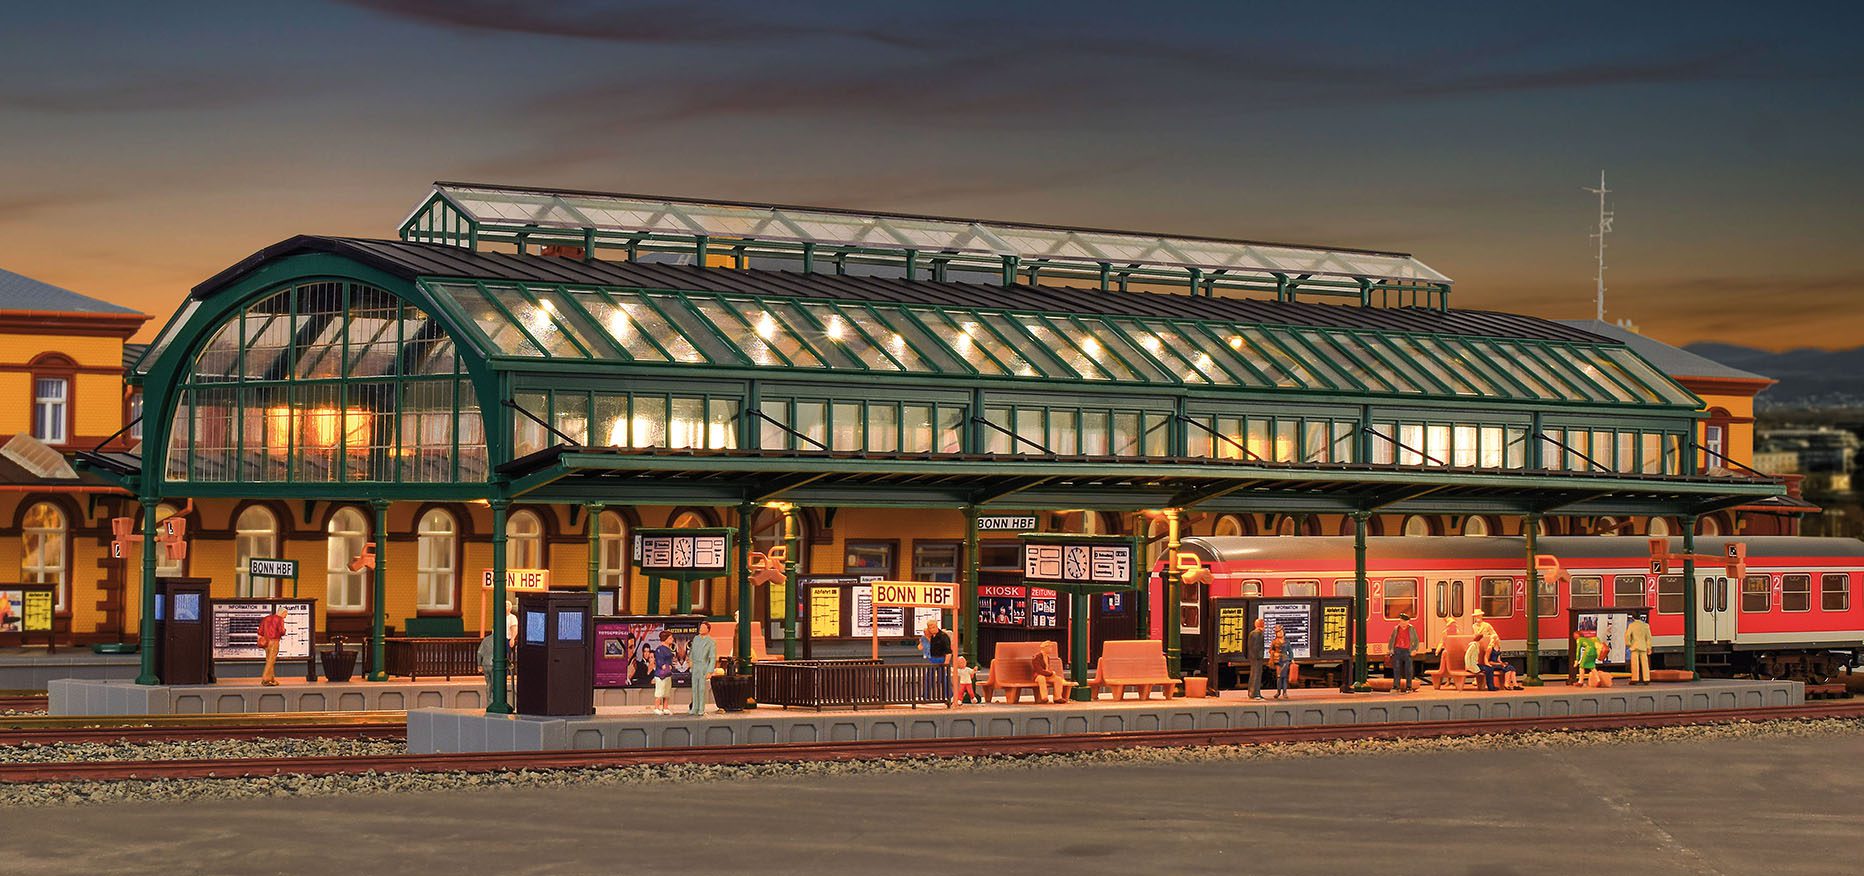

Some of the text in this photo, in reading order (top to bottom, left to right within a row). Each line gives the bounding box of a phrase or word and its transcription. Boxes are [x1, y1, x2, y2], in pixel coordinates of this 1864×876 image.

[977, 519, 1034, 528] BONN HBF
[252, 562, 292, 574] BONN HBF
[486, 572, 541, 588] BN HBF
[1516, 580, 1524, 594] 2
[1648, 578, 1656, 592] 2
[1773, 577, 1780, 591] 2
[877, 585, 951, 604] BONN HBF
[986, 586, 1019, 596] KIOSK
[1373, 582, 1381, 596] 2
